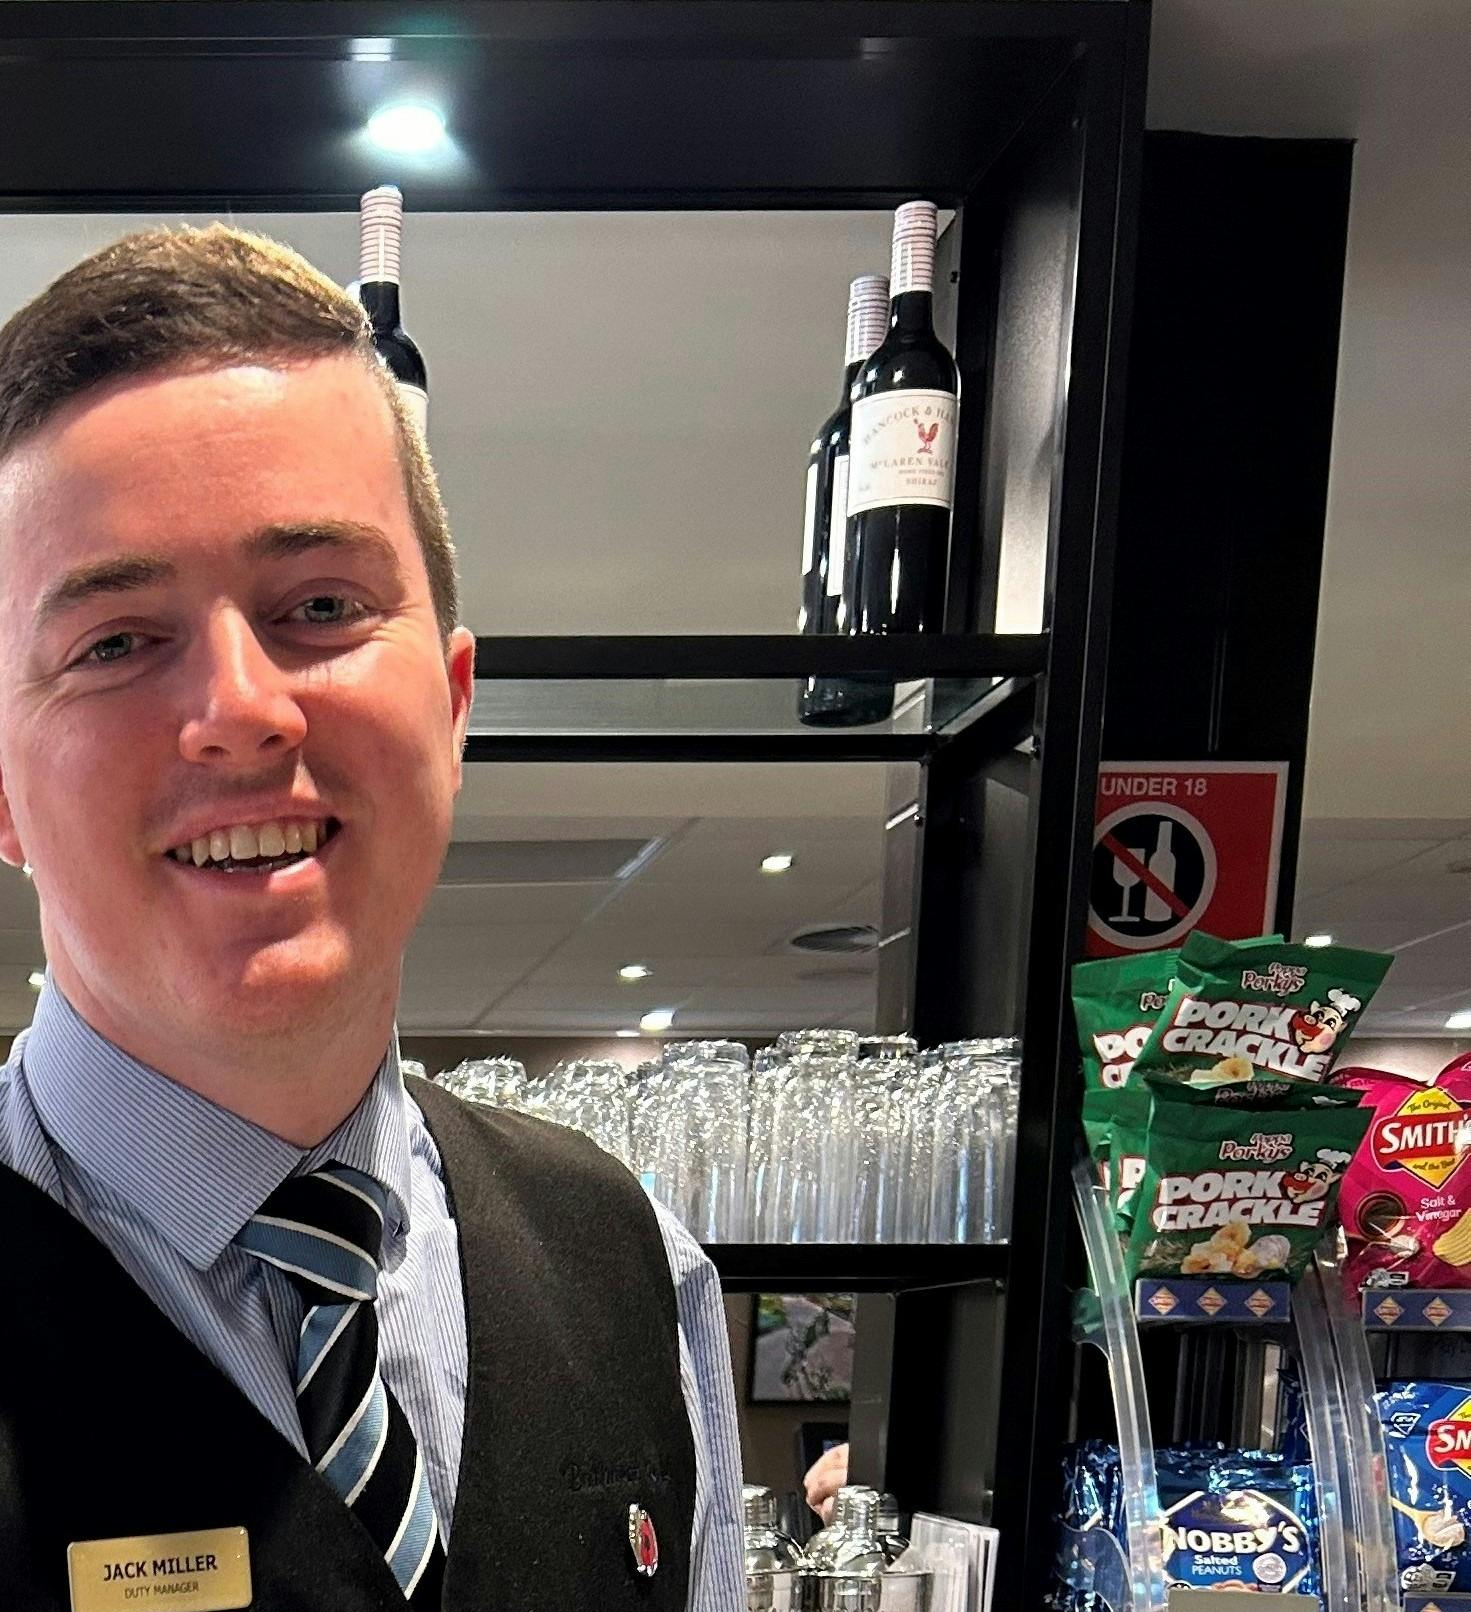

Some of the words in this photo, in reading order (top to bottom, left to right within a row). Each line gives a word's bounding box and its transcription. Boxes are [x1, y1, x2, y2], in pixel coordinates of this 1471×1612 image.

[1101, 777, 1178, 796] UNDER
[1184, 777, 1208, 796] 18
[1174, 998, 1298, 1042] PORK
[1094, 1026, 1153, 1062] PO
[1163, 1027, 1332, 1082] CRACKLE
[1159, 1171, 1286, 1204] PORK
[1416, 1209, 1462, 1222] Vinegar
[1420, 1195, 1445, 1209] Salt
[1447, 1195, 1456, 1205] &
[1152, 1200, 1326, 1232] CRACKLE
[1161, 1520, 1301, 1553] NOBBY'S
[104, 1560, 148, 1581] JACK
[152, 1554, 218, 1577] MILLER
[1192, 1565, 1242, 1576] PEANUTS
[1194, 1554, 1238, 1566] Salted
[125, 1585, 150, 1599] DUTY
[153, 1581, 199, 1596] MANAGER
